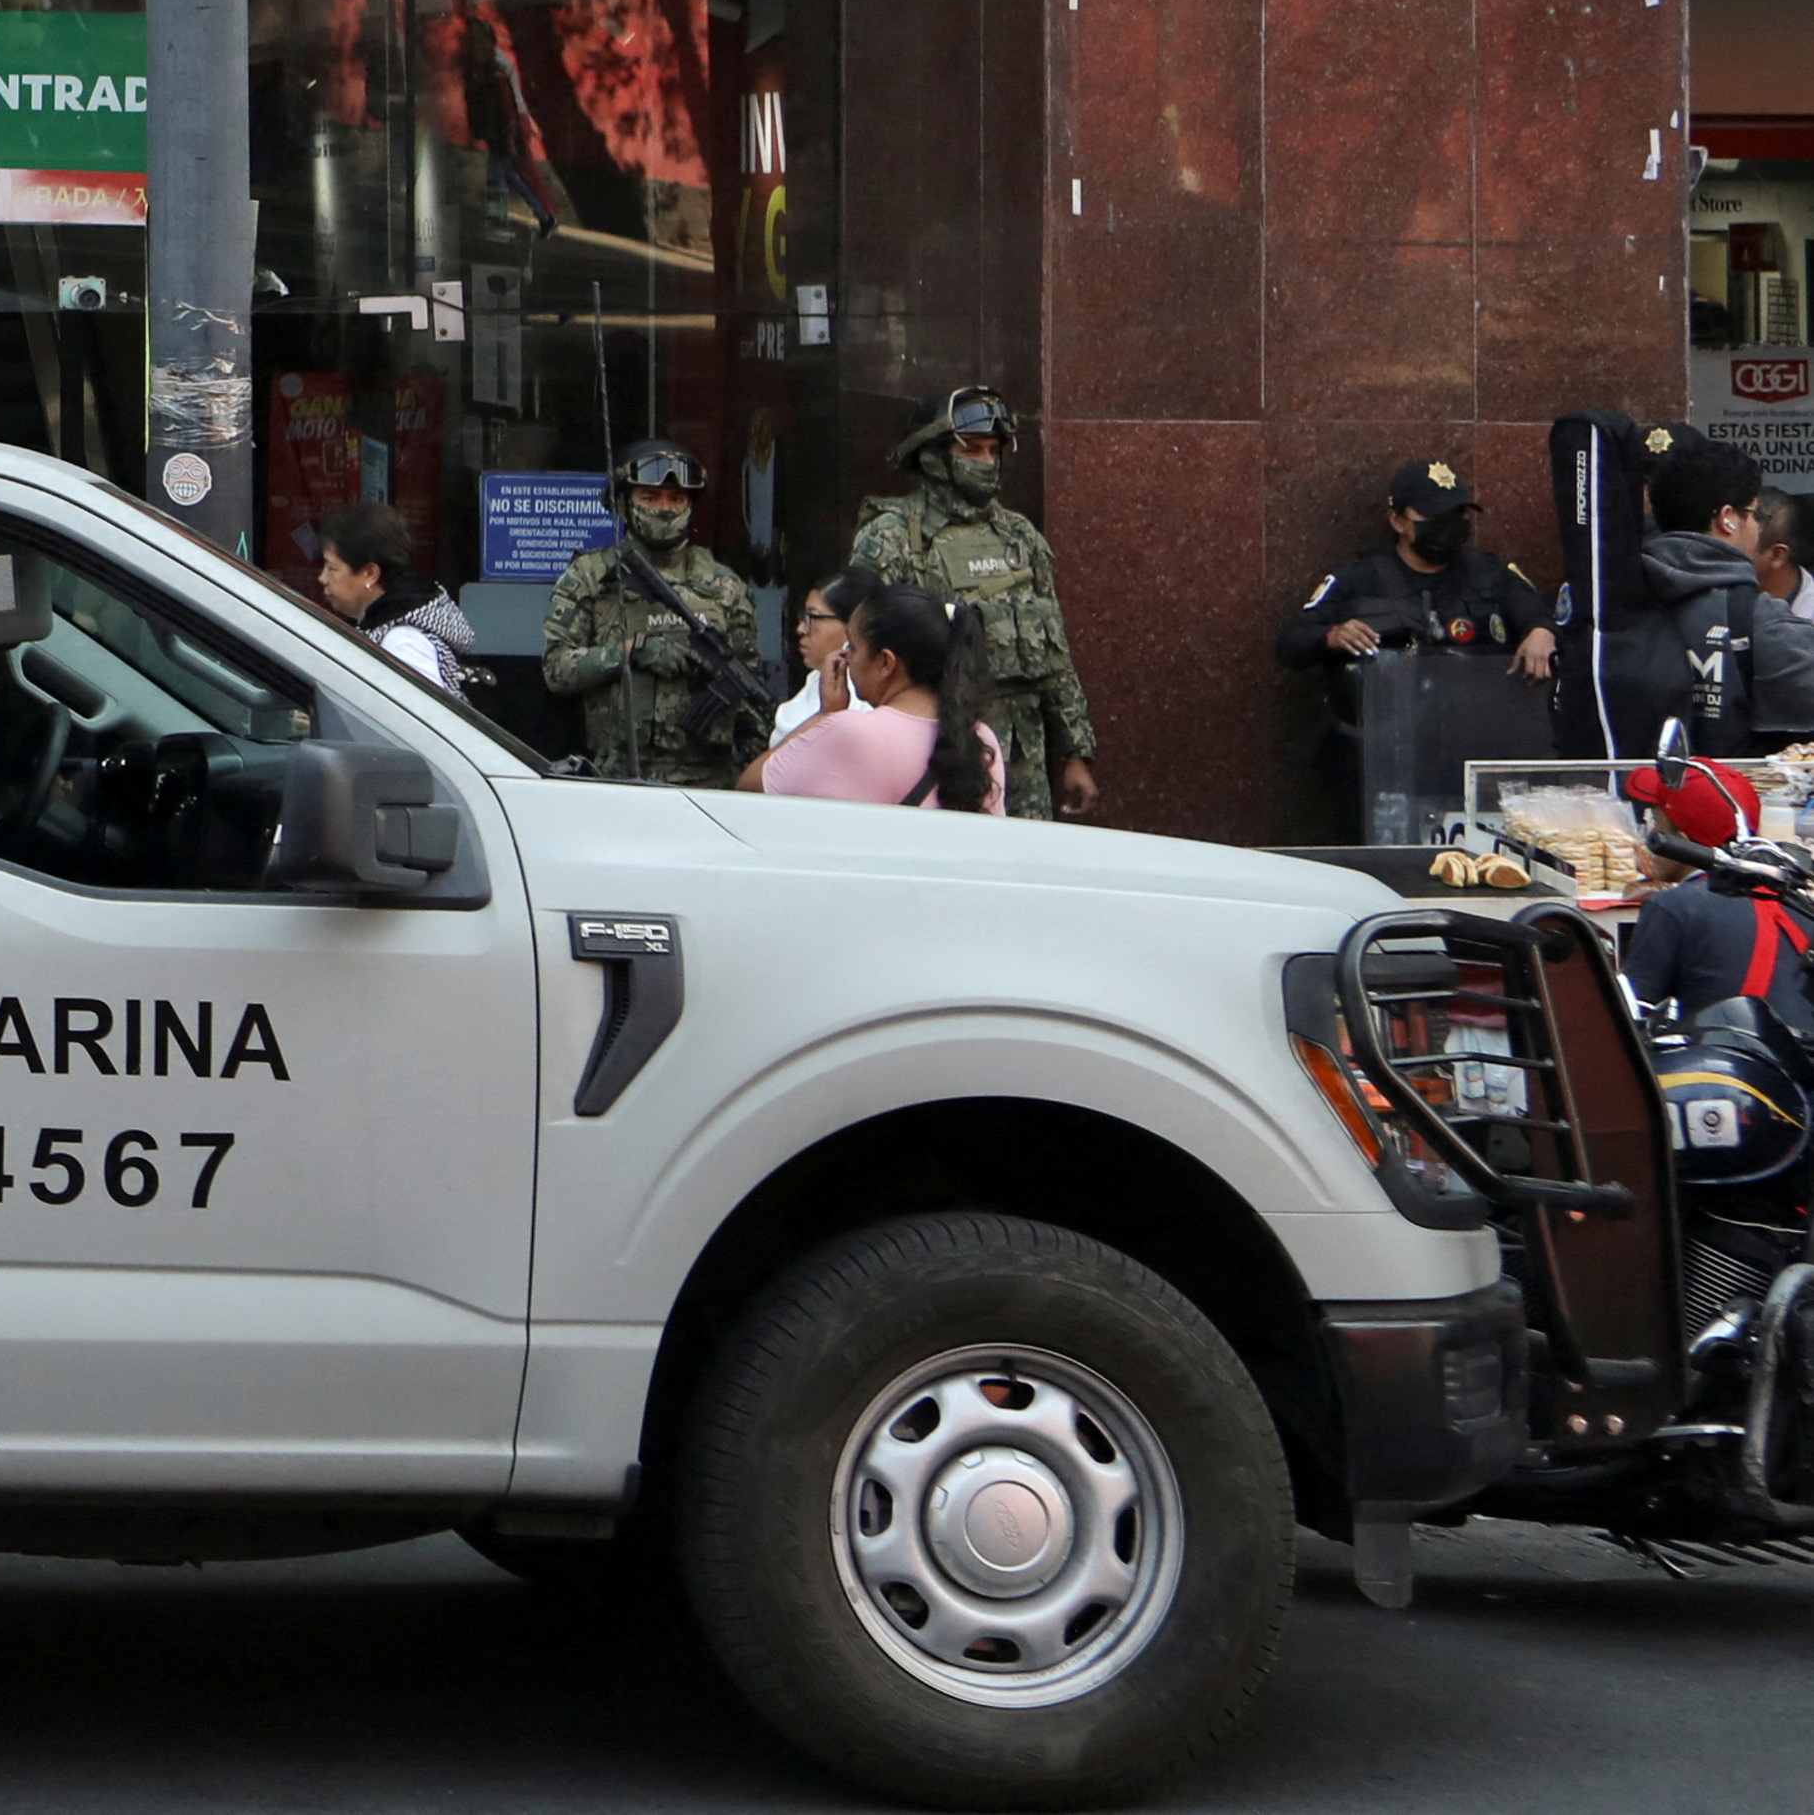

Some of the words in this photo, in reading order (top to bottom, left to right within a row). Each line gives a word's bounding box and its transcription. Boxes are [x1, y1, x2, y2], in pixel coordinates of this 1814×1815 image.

[1698, 191, 1743, 214] Store
[1735, 362, 1806, 394] OGGI
[289, 394, 345, 420] GAN
[1708, 423, 1760, 438] ESTAS
[1764, 423, 1814, 438] FIEST
[1766, 441, 1793, 456] UN
[501, 486, 512, 495] EN
[513, 486, 531, 496] ESTE
[533, 486, 602, 497] ESTABLECIMIENTO
[491, 498, 511, 513] NO
[513, 499, 531, 513] SE
[535, 499, 610, 515] DISCRIMIN
[489, 517, 505, 526] POR
[506, 517, 540, 527] MOTIVOS
[542, 517, 552, 527] DE
[509, 527, 559, 537] ORIENTACIÓN
[516, 537, 558, 548] CONDICIÓN
[559, 538, 584, 549] FÍSICA
[512, 550, 518, 559] O
[495, 561, 504, 570] NI
[505, 561, 520, 570] POR
[522, 560, 551, 571] NINGÚN
[553, 561, 570, 571] OTR
[579, 922, 670, 941] F-150
